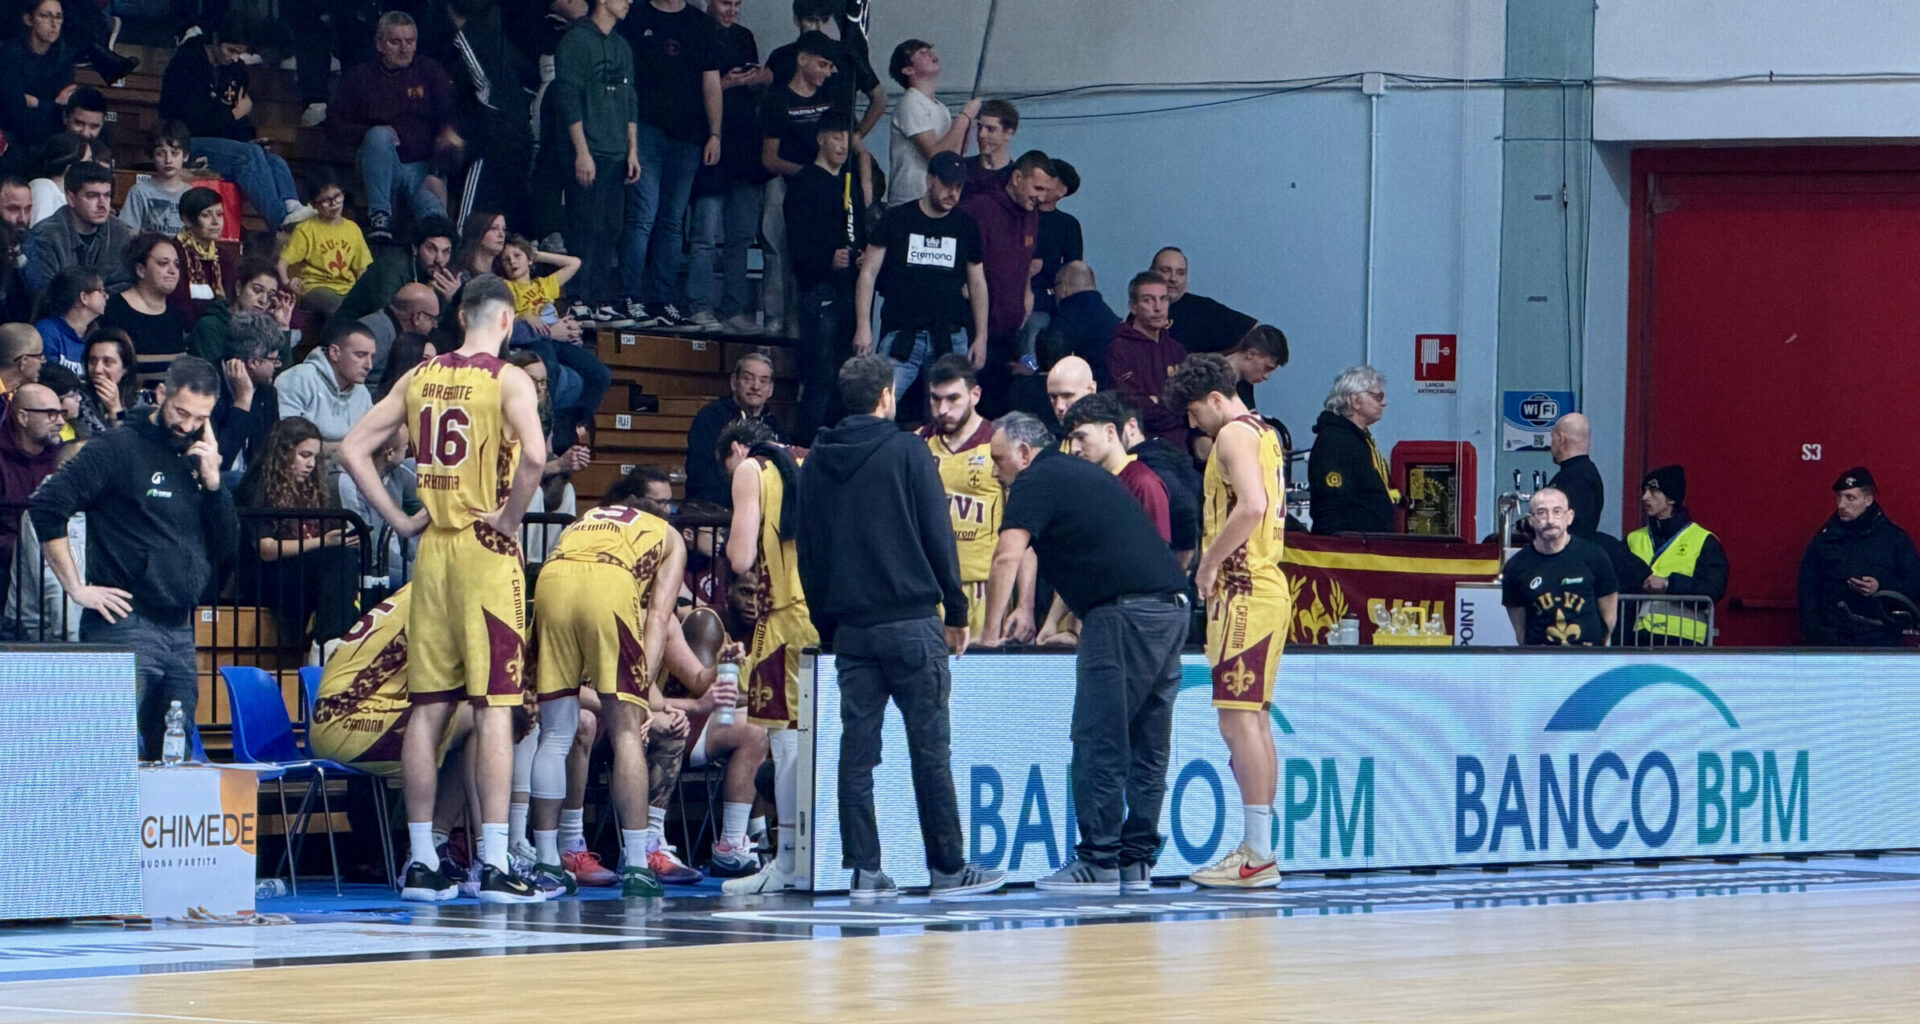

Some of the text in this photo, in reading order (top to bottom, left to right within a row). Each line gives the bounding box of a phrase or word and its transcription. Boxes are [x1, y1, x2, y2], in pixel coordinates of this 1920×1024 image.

[414, 403, 471, 469] 16
[1801, 443, 1822, 461] S3
[511, 579, 524, 630] CREMONA
[1232, 605, 1248, 649] CREMONA
[970, 757, 1375, 872] BAO PM
[1455, 750, 1809, 853] BANCO BPM
[140, 813, 255, 849] CHIMEDE
